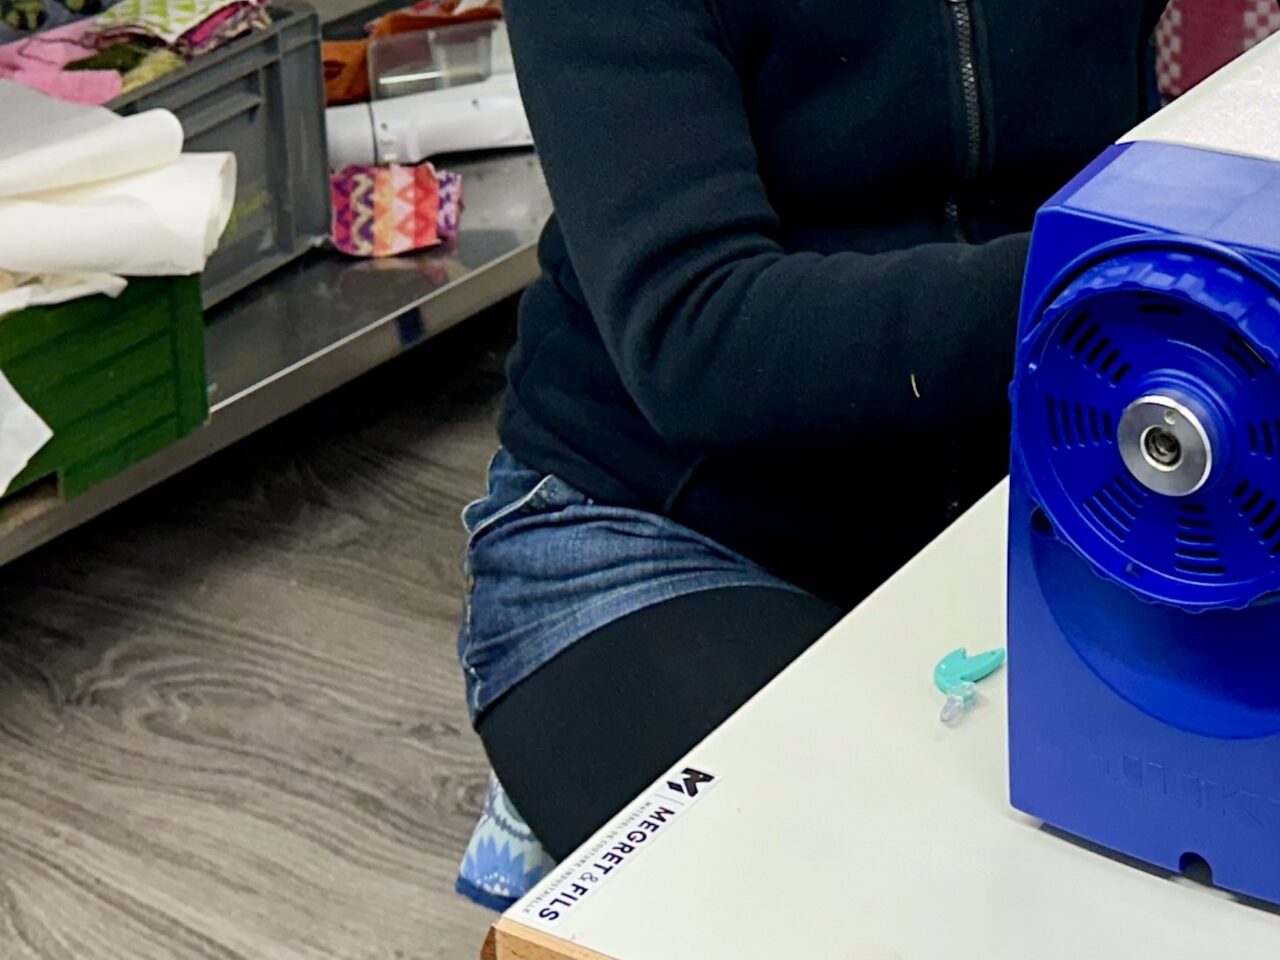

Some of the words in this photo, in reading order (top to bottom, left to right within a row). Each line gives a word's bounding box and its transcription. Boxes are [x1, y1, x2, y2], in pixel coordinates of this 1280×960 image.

[594, 806, 675, 875] MEGRET
[578, 872, 599, 883] &
[539, 883, 588, 921] FILS
